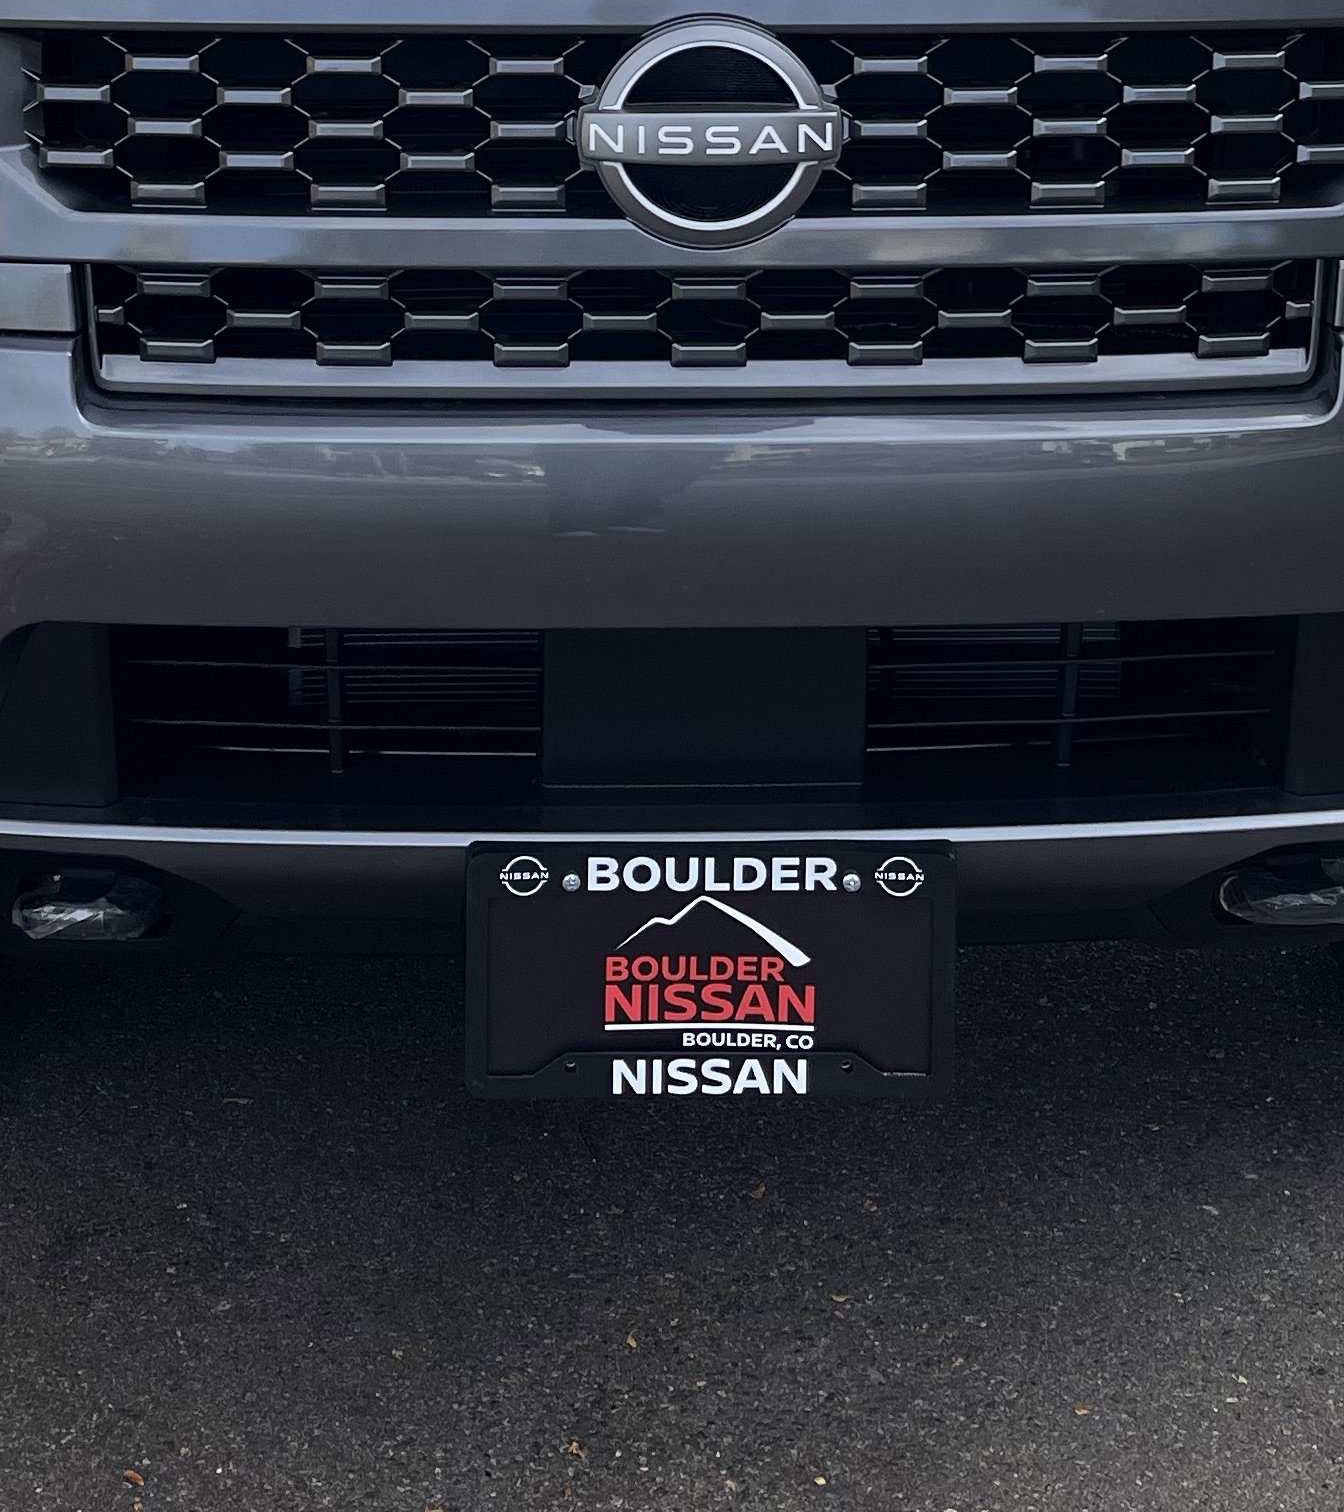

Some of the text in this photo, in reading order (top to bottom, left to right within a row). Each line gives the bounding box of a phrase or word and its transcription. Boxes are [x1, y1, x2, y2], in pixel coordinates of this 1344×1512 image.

[588, 122, 833, 155] NISSAN
[499, 870, 549, 881] NISSAN
[587, 856, 838, 892] BOULDER
[874, 870, 925, 882] NISSAN
[605, 955, 785, 982] BOULDER
[604, 983, 816, 1024] NISSAN
[682, 1032, 814, 1051] BOULDER, CO
[611, 1058, 808, 1096] NISSAN
